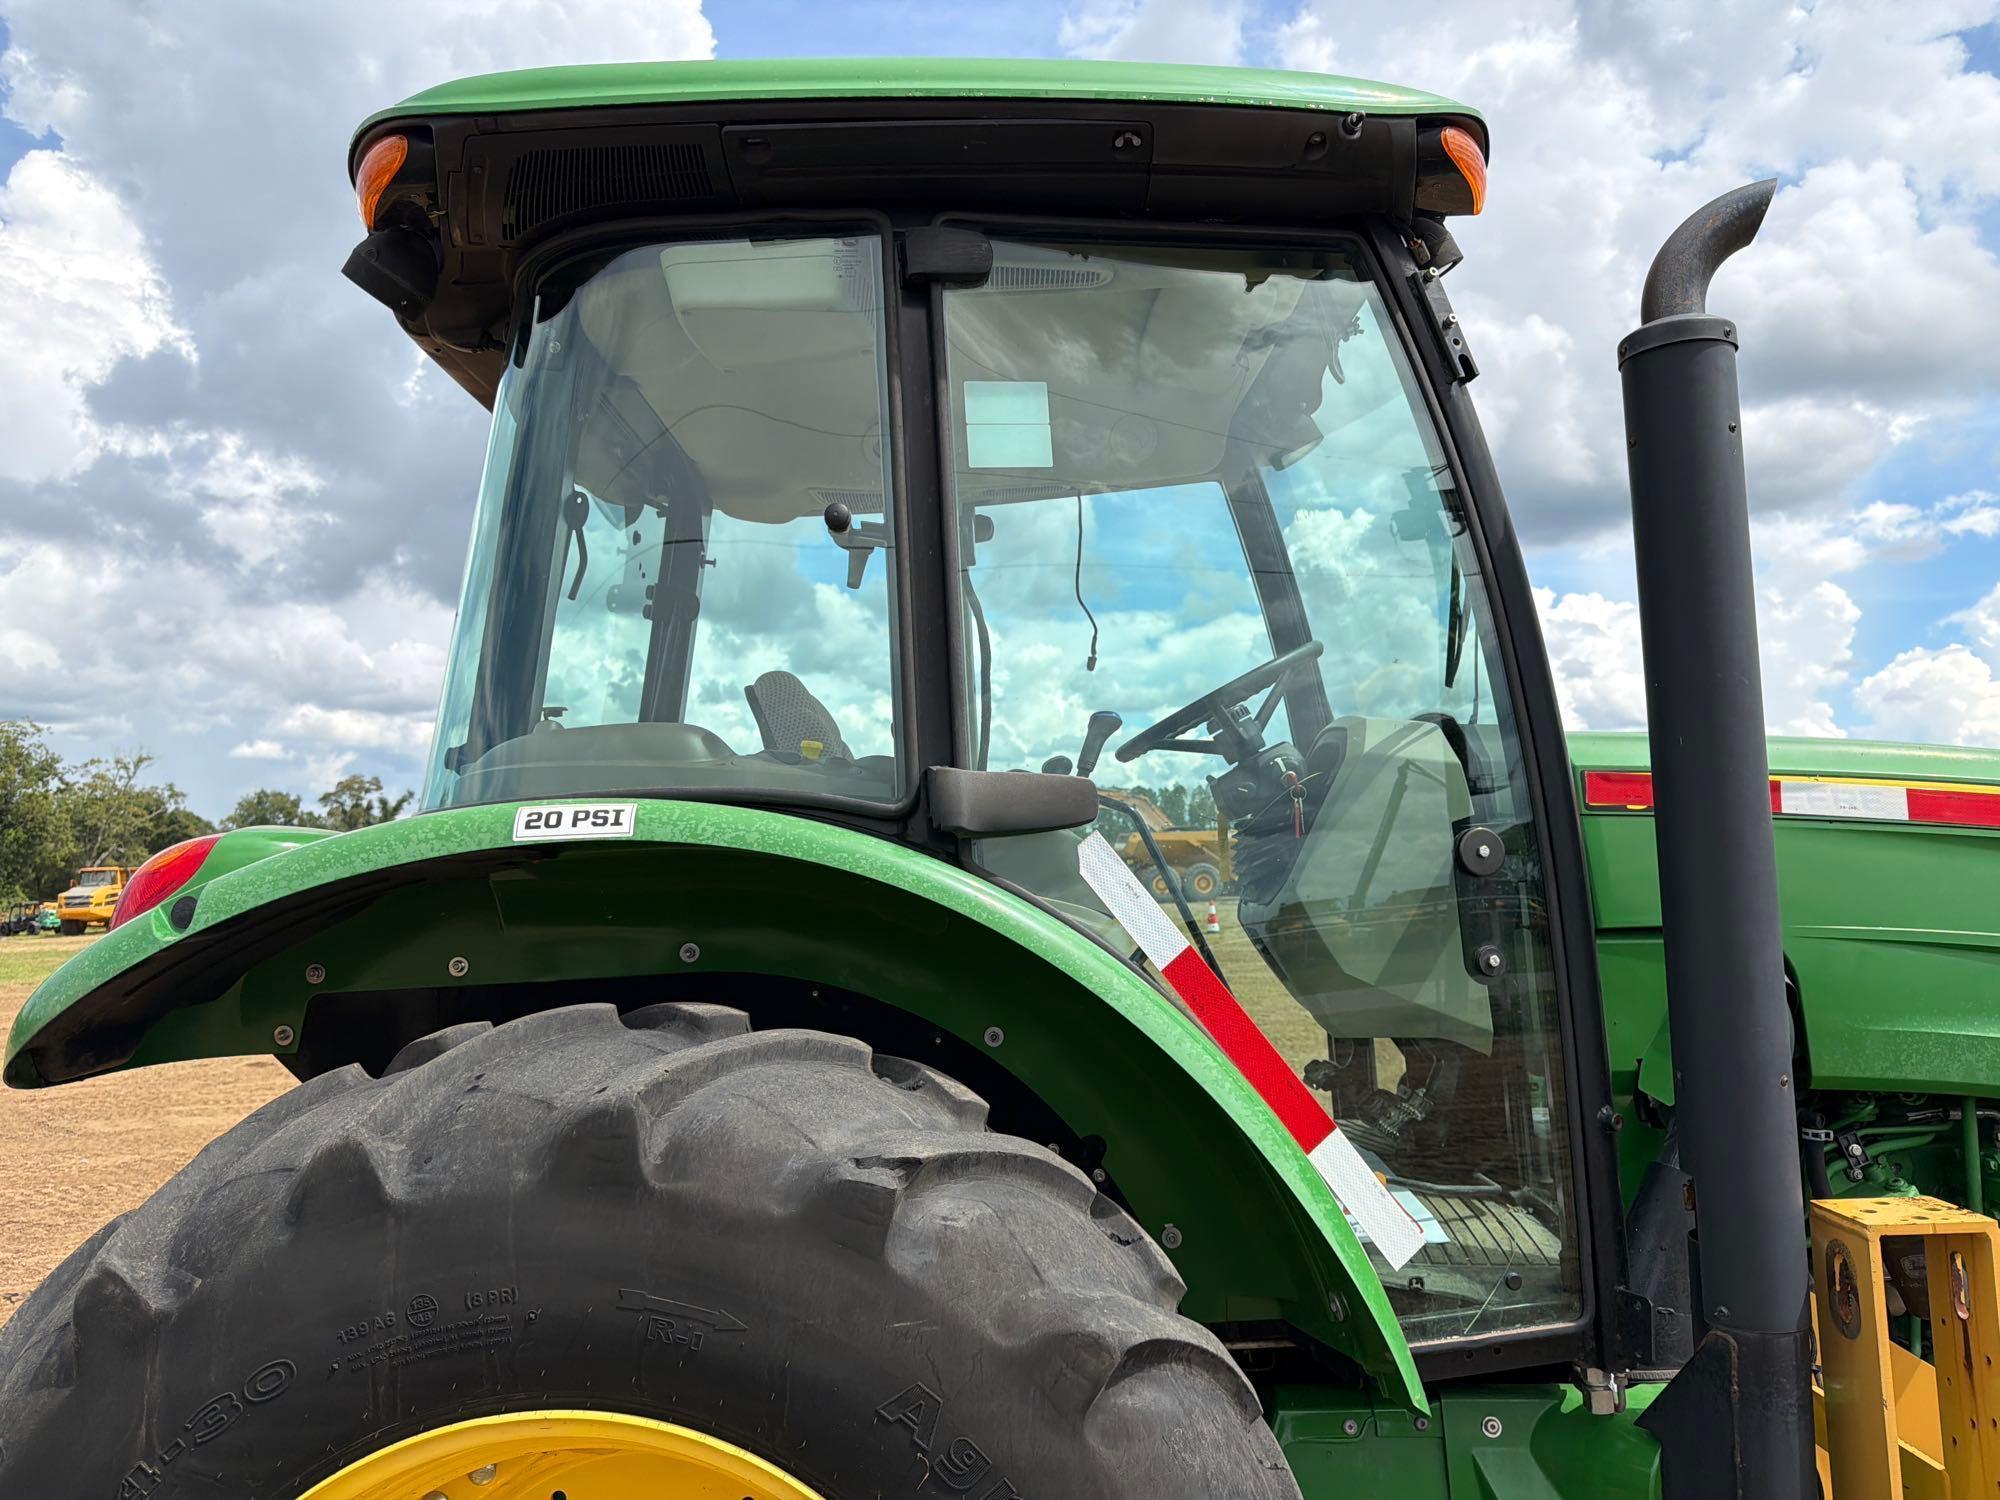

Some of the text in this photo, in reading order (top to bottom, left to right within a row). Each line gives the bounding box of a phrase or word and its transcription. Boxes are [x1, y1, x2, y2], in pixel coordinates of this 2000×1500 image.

[525, 809, 625, 830] 20 PSI
[875, 1381, 1023, 1500] Ag
